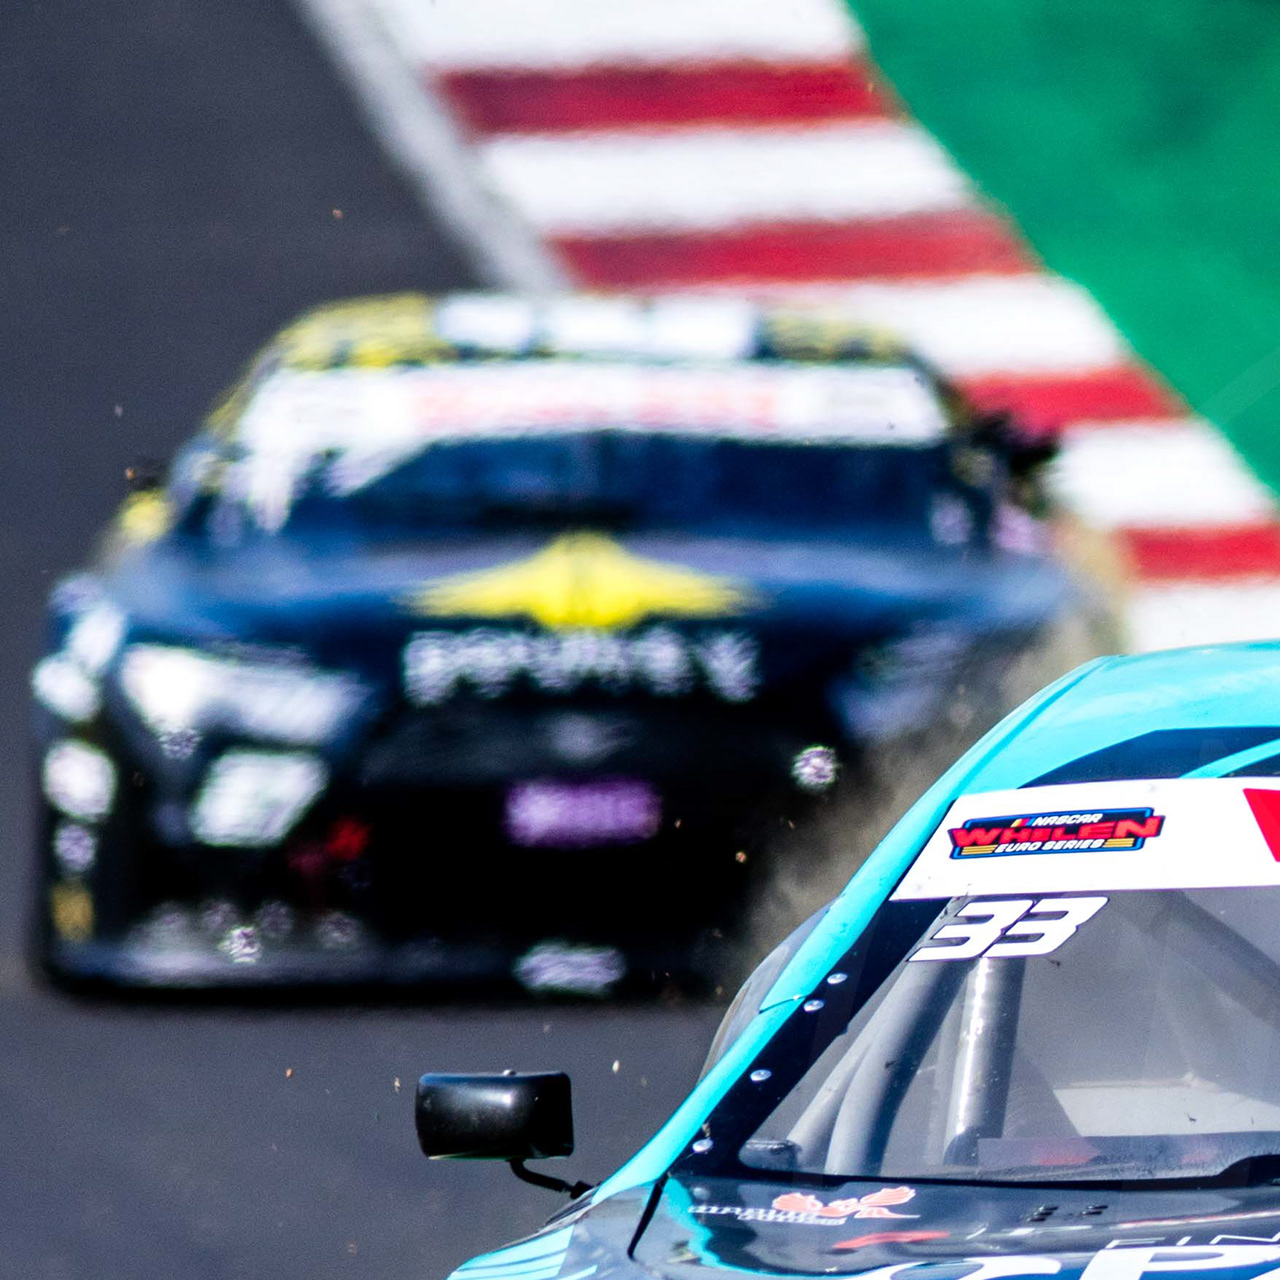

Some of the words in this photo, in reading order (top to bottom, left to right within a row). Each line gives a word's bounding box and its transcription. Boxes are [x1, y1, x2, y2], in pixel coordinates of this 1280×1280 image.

[951, 815, 1162, 847] WHELEN
[1032, 813, 1103, 827] NASCAR
[994, 841, 1039, 854] EURO
[1040, 838, 1105, 851] SERIES
[906, 896, 1109, 963] 33
